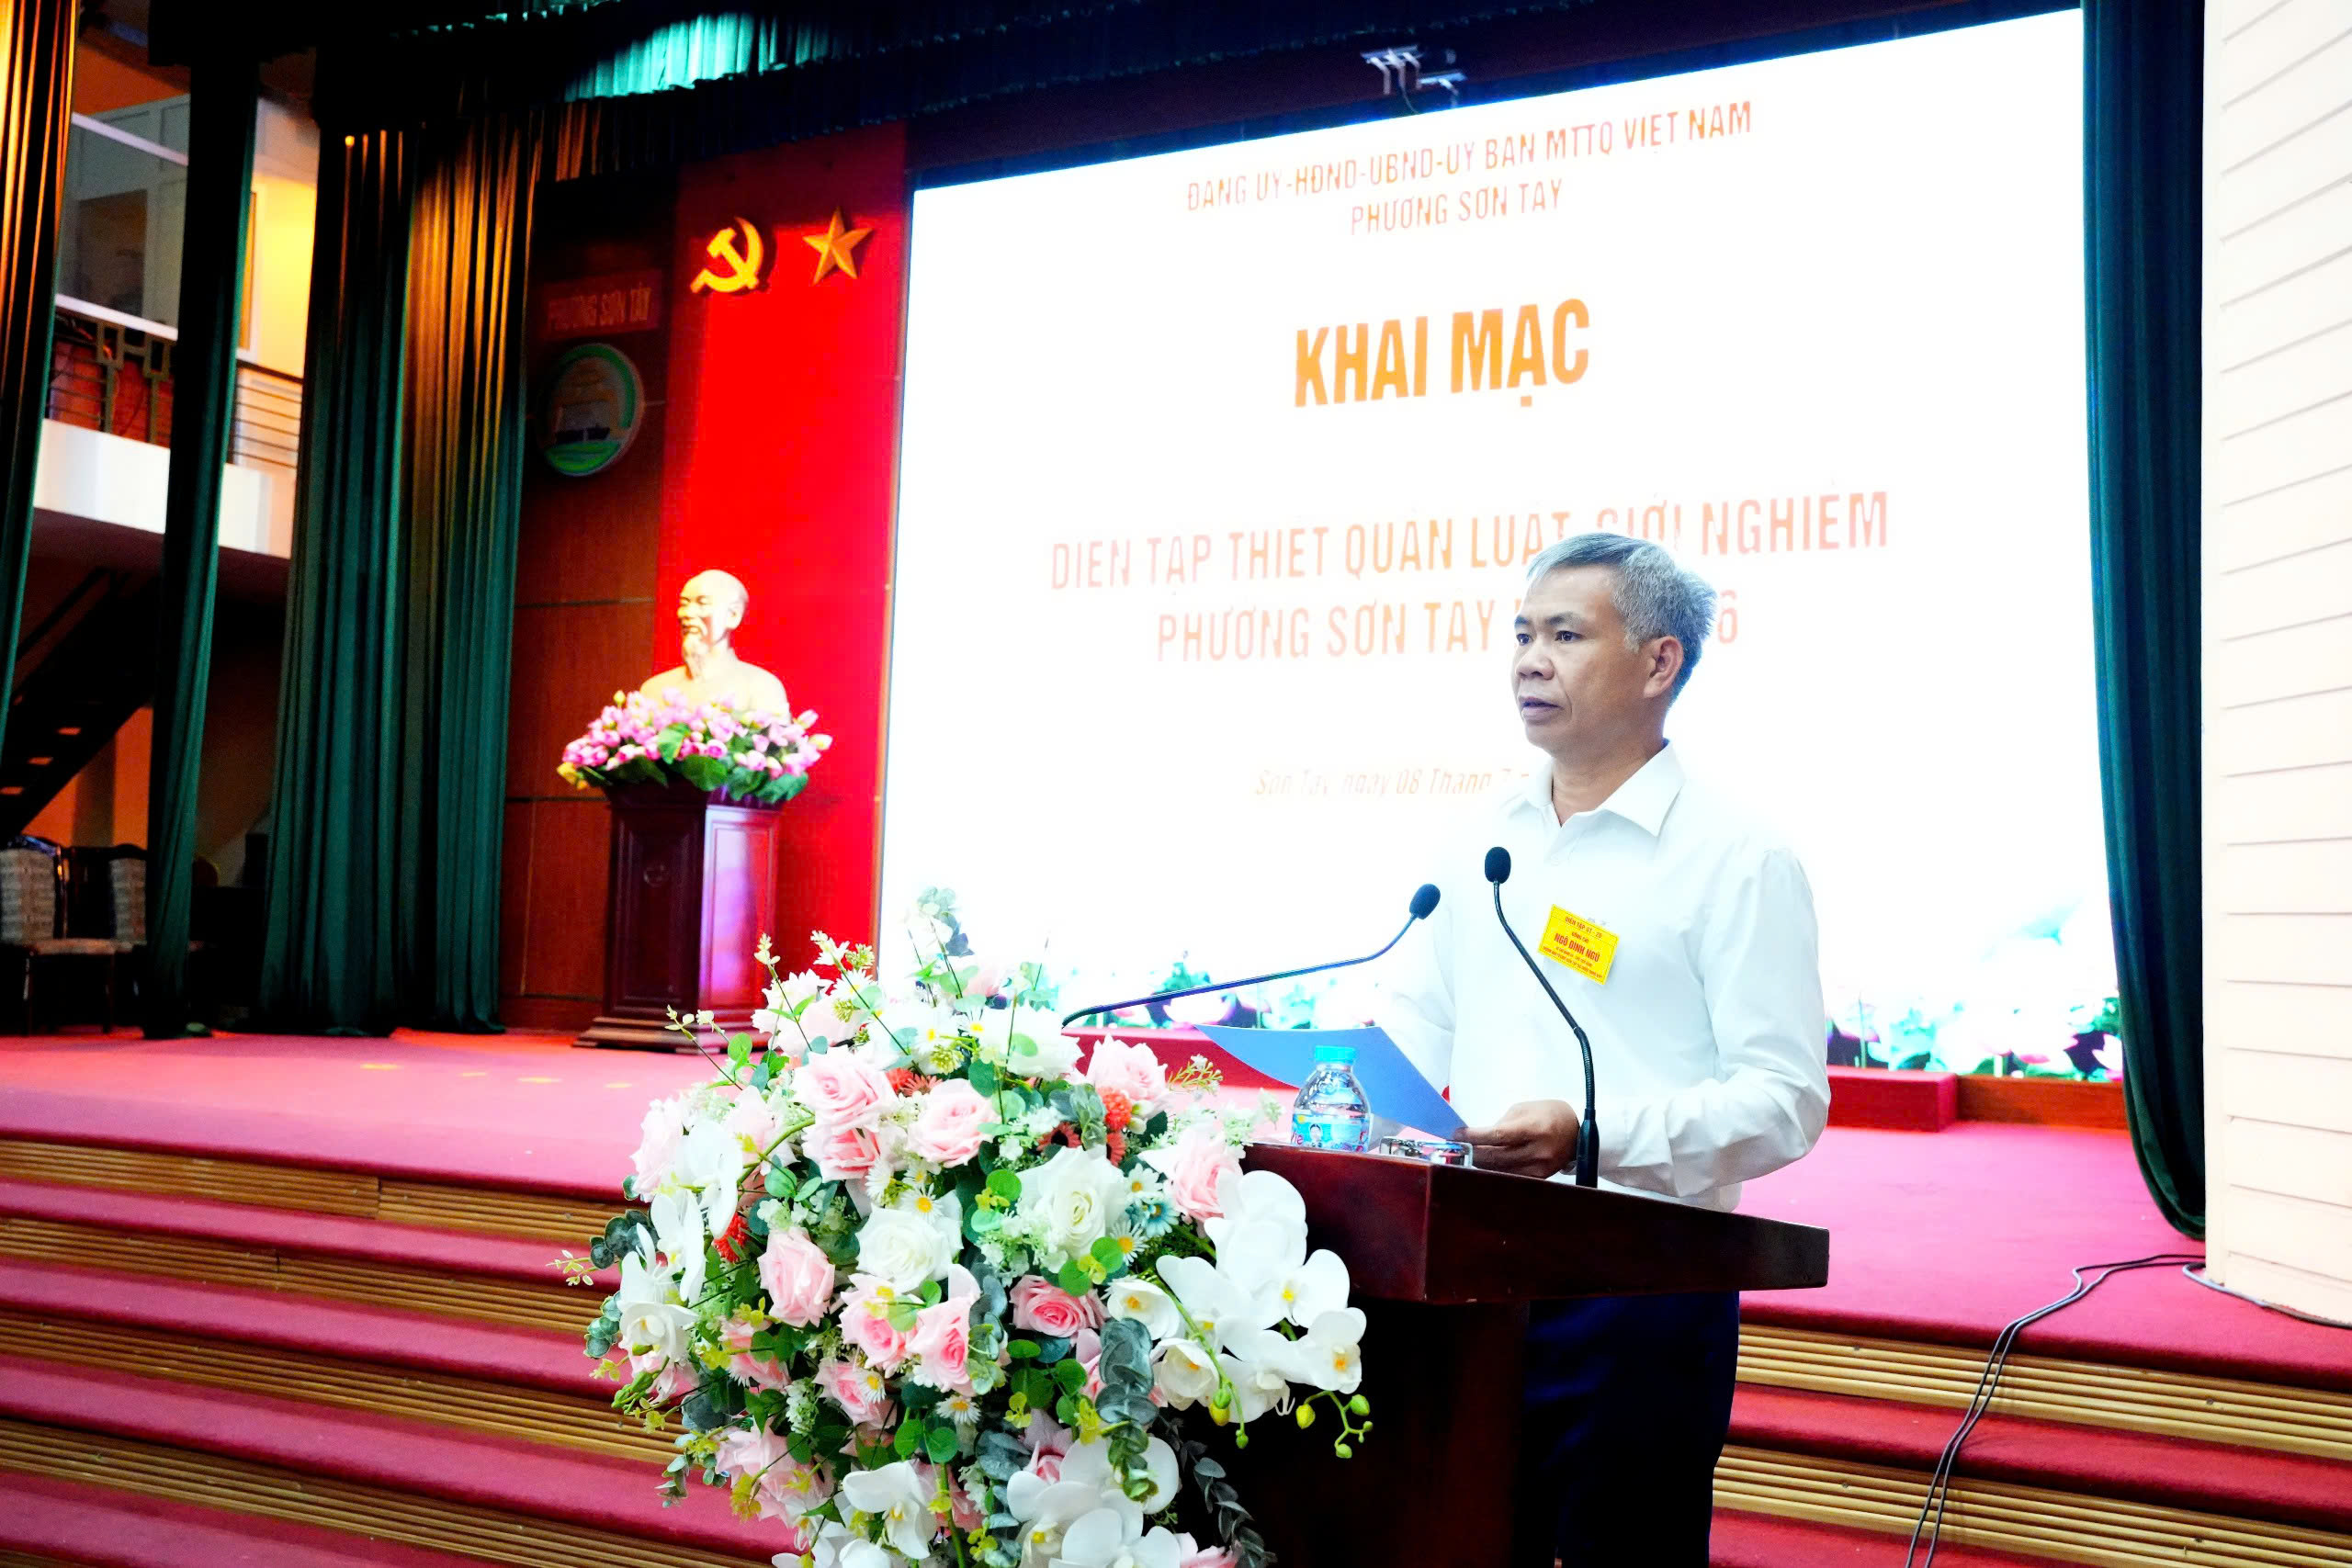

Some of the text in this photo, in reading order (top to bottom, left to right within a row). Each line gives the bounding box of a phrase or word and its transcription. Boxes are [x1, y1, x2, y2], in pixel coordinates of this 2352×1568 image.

[1546, 121, 1613, 159] MTTQ
[1688, 100, 1752, 141] NAM
[1294, 297, 1591, 408] KHAI MẠC
